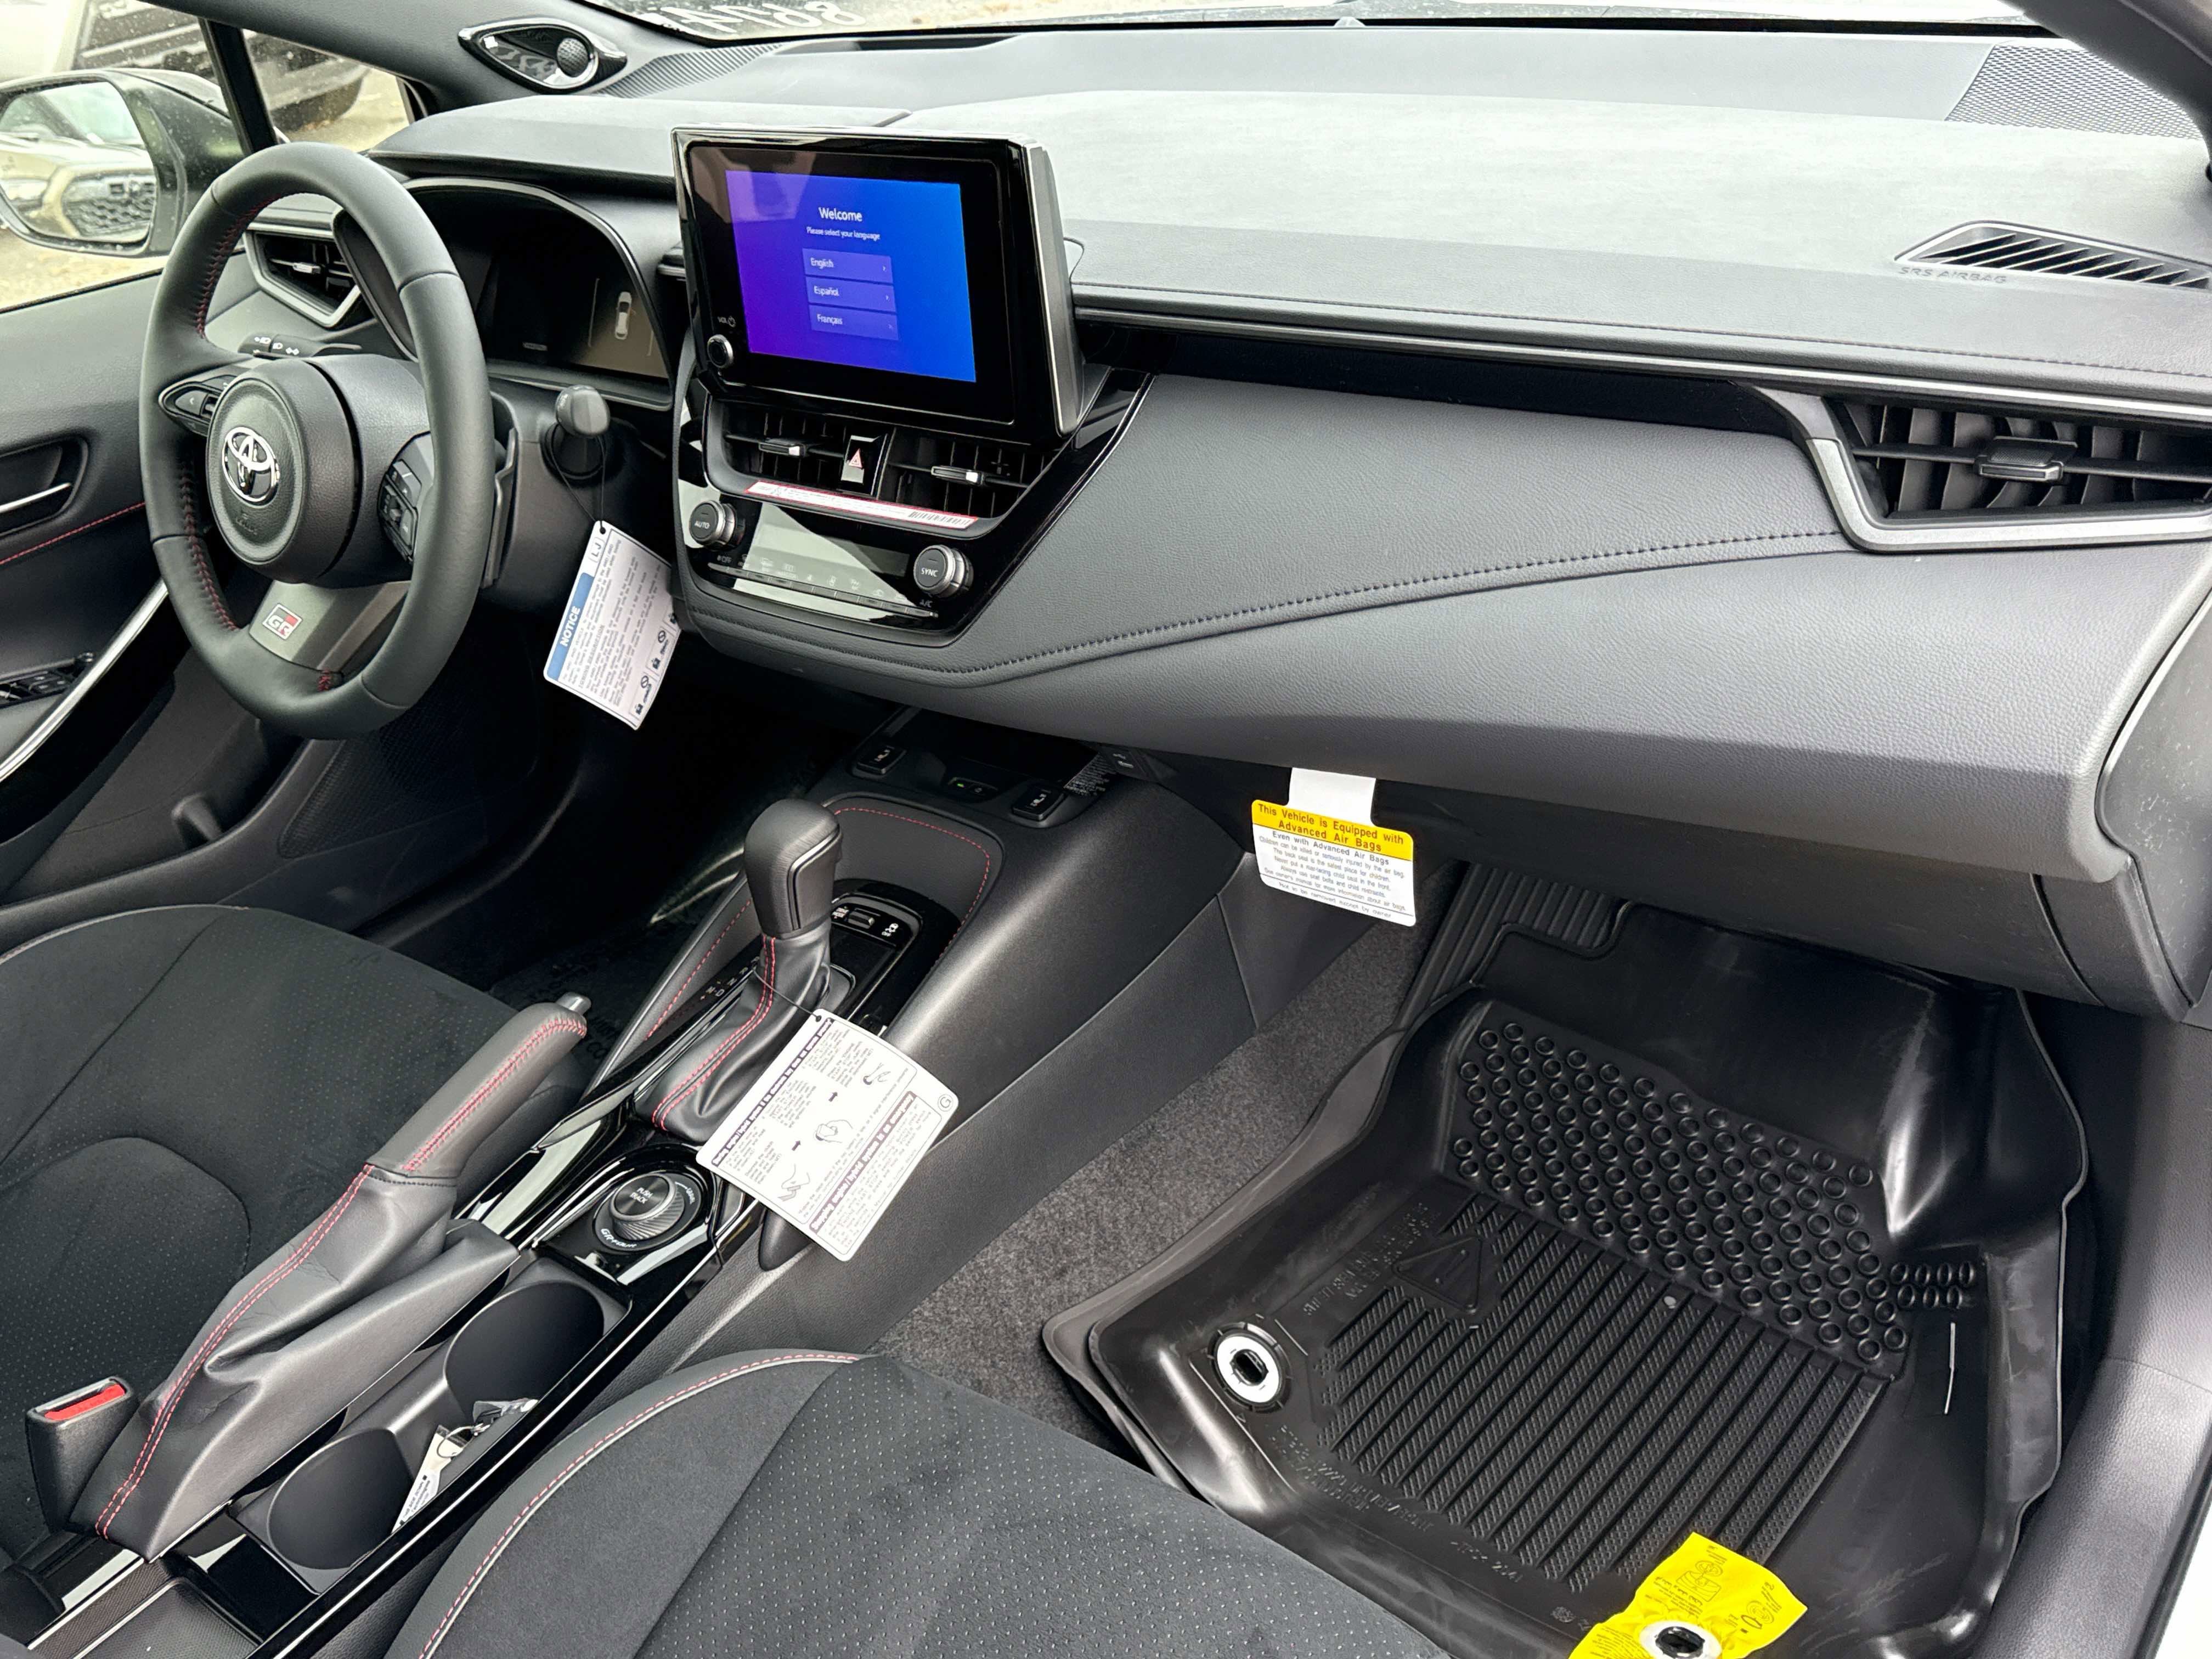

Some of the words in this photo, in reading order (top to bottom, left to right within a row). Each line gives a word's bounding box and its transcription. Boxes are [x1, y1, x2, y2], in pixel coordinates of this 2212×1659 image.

[819, 207, 862, 221] Welcome
[806, 227, 823, 235] Please
[854, 231, 880, 241] language
[811, 258, 833, 269] English
[1898, 267, 1932, 277] SRS
[1936, 269, 2007, 284] AIRBAG
[814, 286, 839, 297] Español
[817, 314, 842, 325] Français
[695, 521, 710, 529] AUTO
[922, 568, 939, 577] SYNC
[269, 614, 294, 636] GR
[559, 606, 580, 647] NOTICE
[1258, 803, 1277, 816] This
[1282, 809, 1314, 825] Vehicle
[1319, 817, 1327, 827] is
[1334, 821, 1377, 839] Equipped
[1384, 833, 1403, 844] with
[1279, 820, 1327, 839] Advanced
[1334, 833, 1348, 844] Air
[1357, 838, 1381, 851] Bags
[1273, 831, 1290, 841] Even
[1294, 837, 1309, 845] with
[1314, 842, 1350, 856] Advanced
[1370, 854, 1389, 865] Bags
[637, 1187, 653, 1197] PUSH
